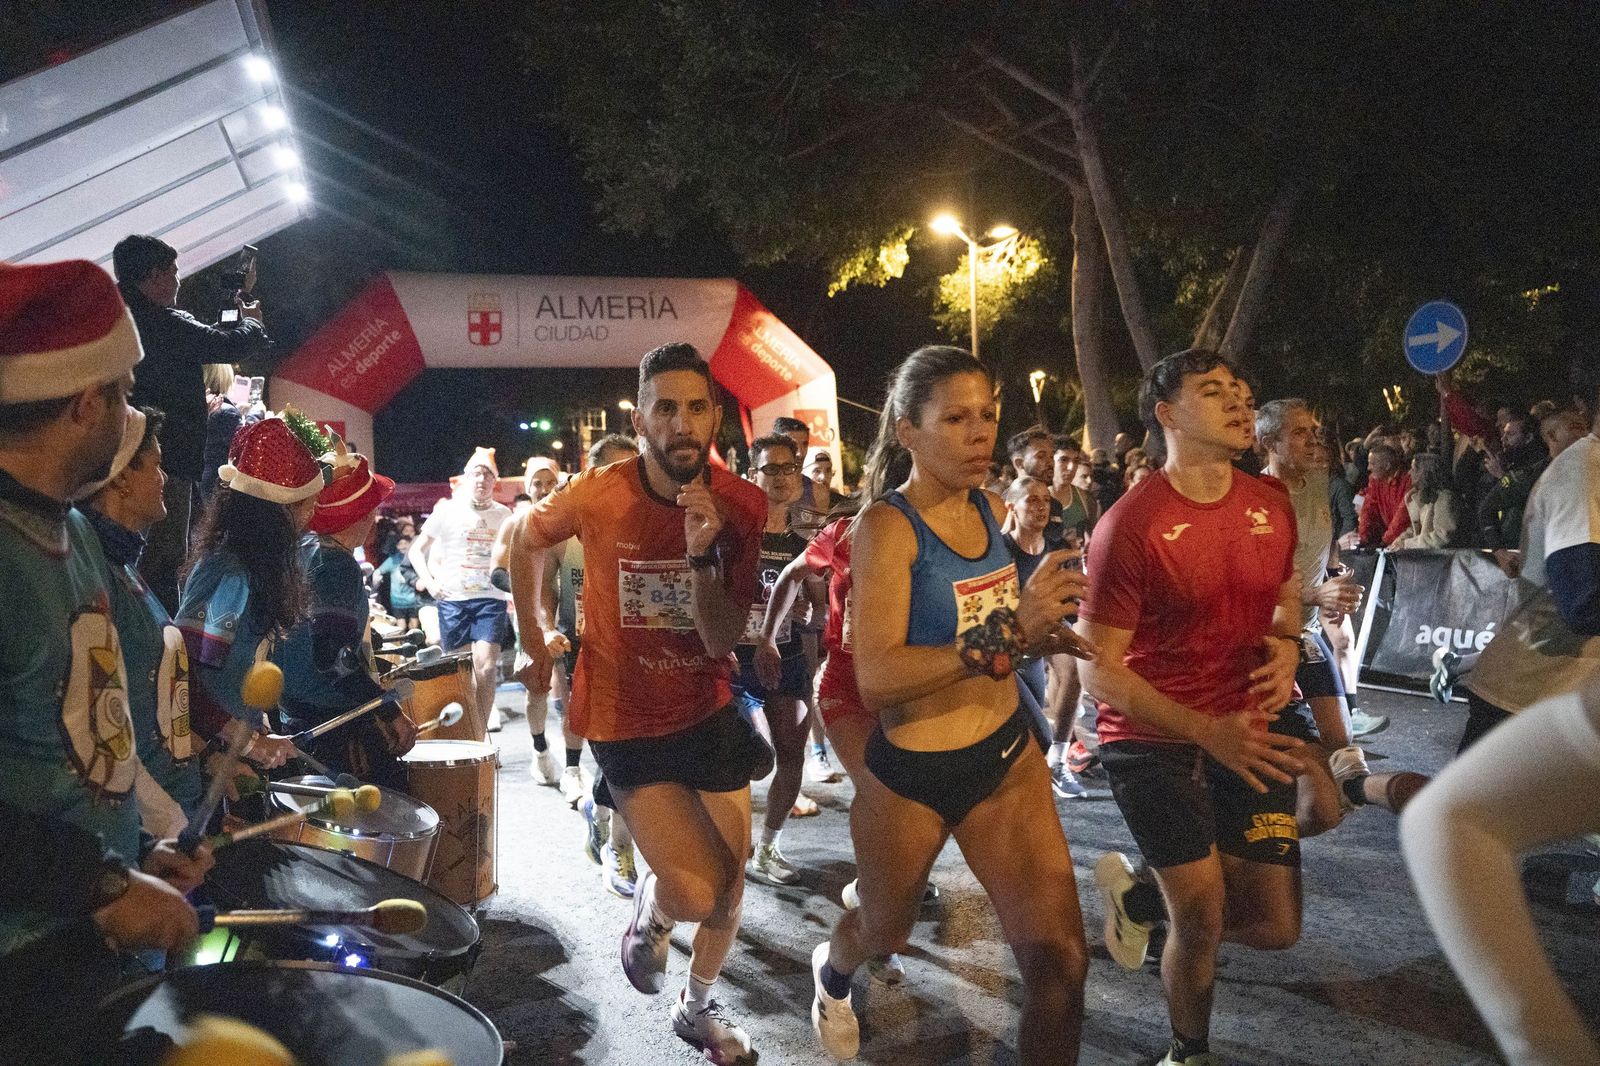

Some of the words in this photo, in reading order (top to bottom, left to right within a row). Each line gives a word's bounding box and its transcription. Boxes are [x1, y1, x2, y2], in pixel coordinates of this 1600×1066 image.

[535, 291, 678, 319] ALMERÍA
[534, 325, 609, 341] CIUDAD
[356, 330, 401, 374] deporte
[750, 342, 793, 382] deporte
[650, 590, 692, 605] 842
